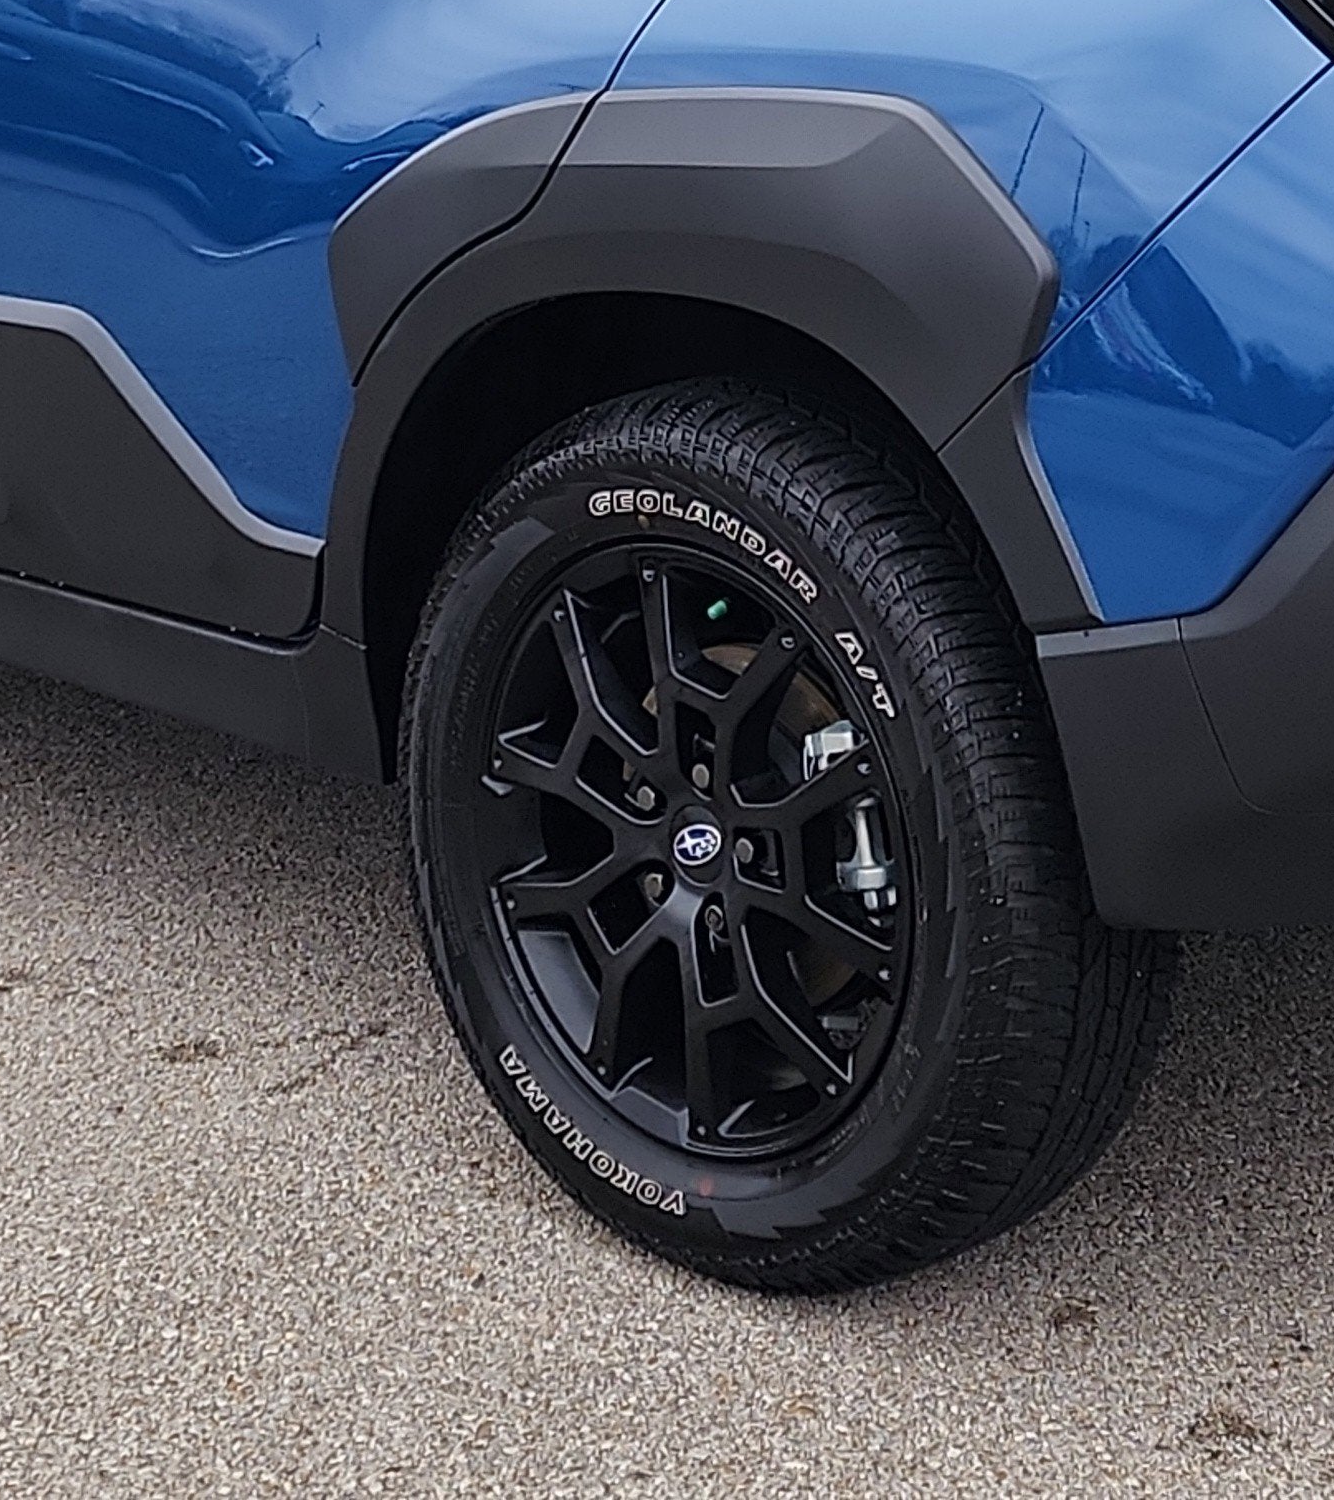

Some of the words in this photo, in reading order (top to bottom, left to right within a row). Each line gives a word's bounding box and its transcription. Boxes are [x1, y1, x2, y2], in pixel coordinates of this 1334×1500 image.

[588, 489, 817, 604] GEOLANDAR
[834, 631, 896, 718] A/T
[499, 1044, 688, 1216] YOKOHAMA
